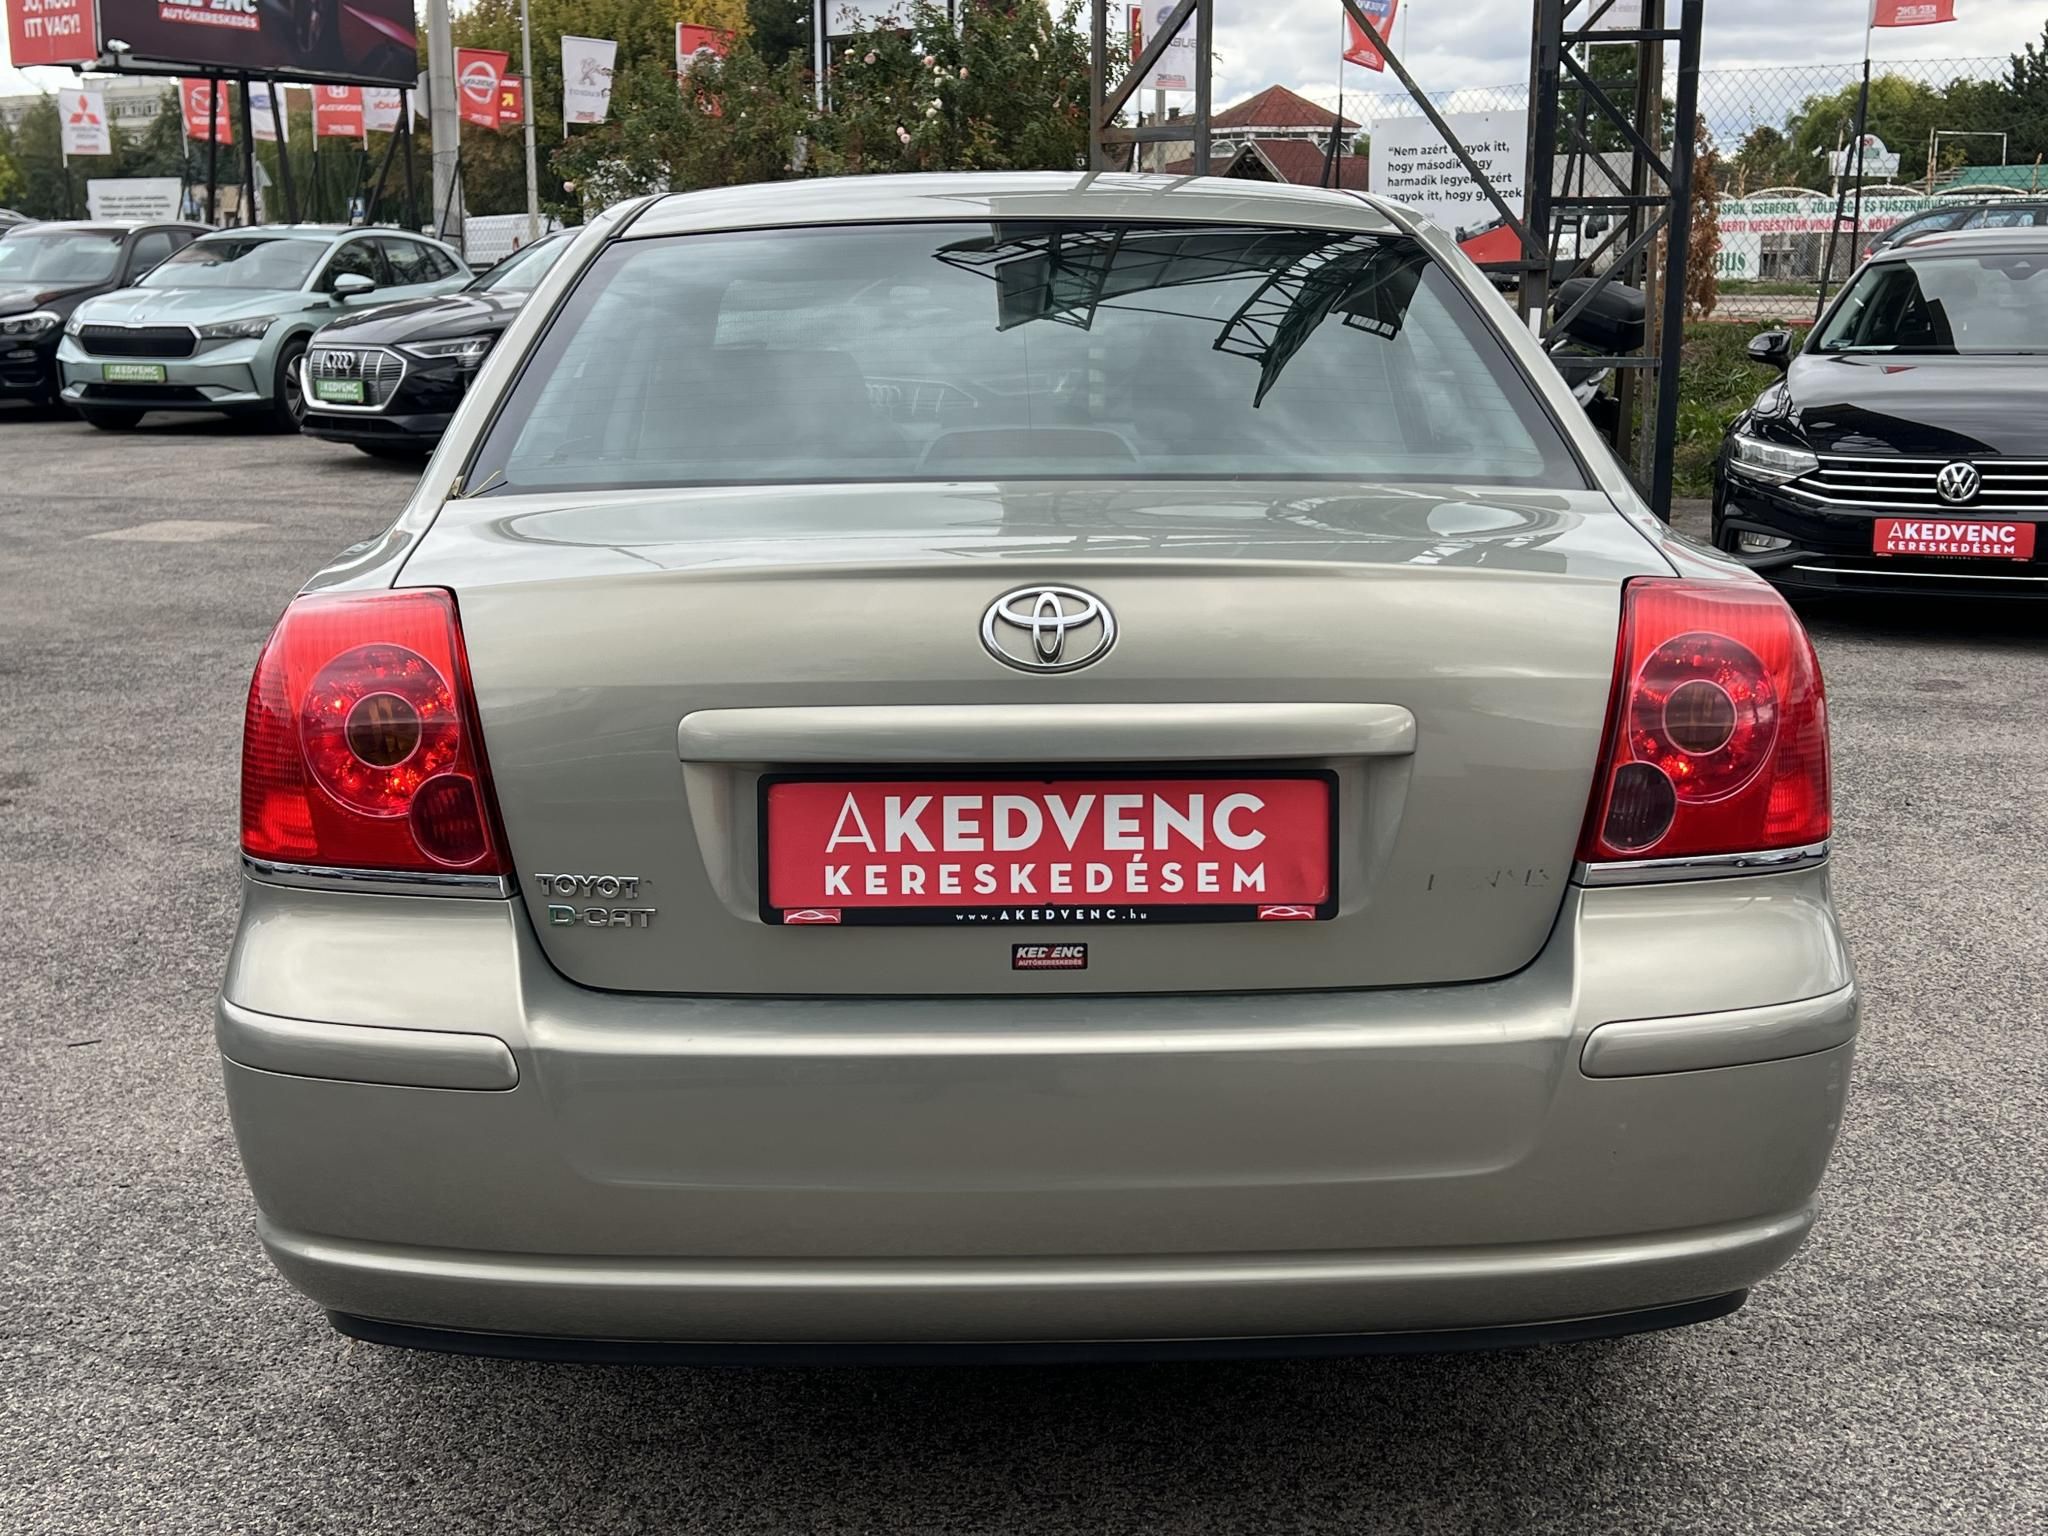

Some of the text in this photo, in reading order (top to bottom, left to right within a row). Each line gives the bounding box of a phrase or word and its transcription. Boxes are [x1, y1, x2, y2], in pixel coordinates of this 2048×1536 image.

[24, 14, 80, 38] ITT VAGY!
[1420, 144, 1448, 155] azért
[1494, 140, 1510, 153] itt,
[1387, 161, 1414, 173] hogy
[1416, 158, 1462, 170] második
[1387, 175, 1437, 187] harmadik
[1488, 171, 1512, 183] zért
[1427, 190, 1442, 202] itt,
[1445, 190, 1473, 202] hogy
[1887, 540, 2015, 554] KERESKEDÉSEM
[825, 854, 1266, 895] KERESKEDÉSEM
[535, 873, 640, 899] TOYOT
[548, 904, 656, 928] D-CAT
[1018, 958, 1082, 966] AUTÓKERESKEDÉS
